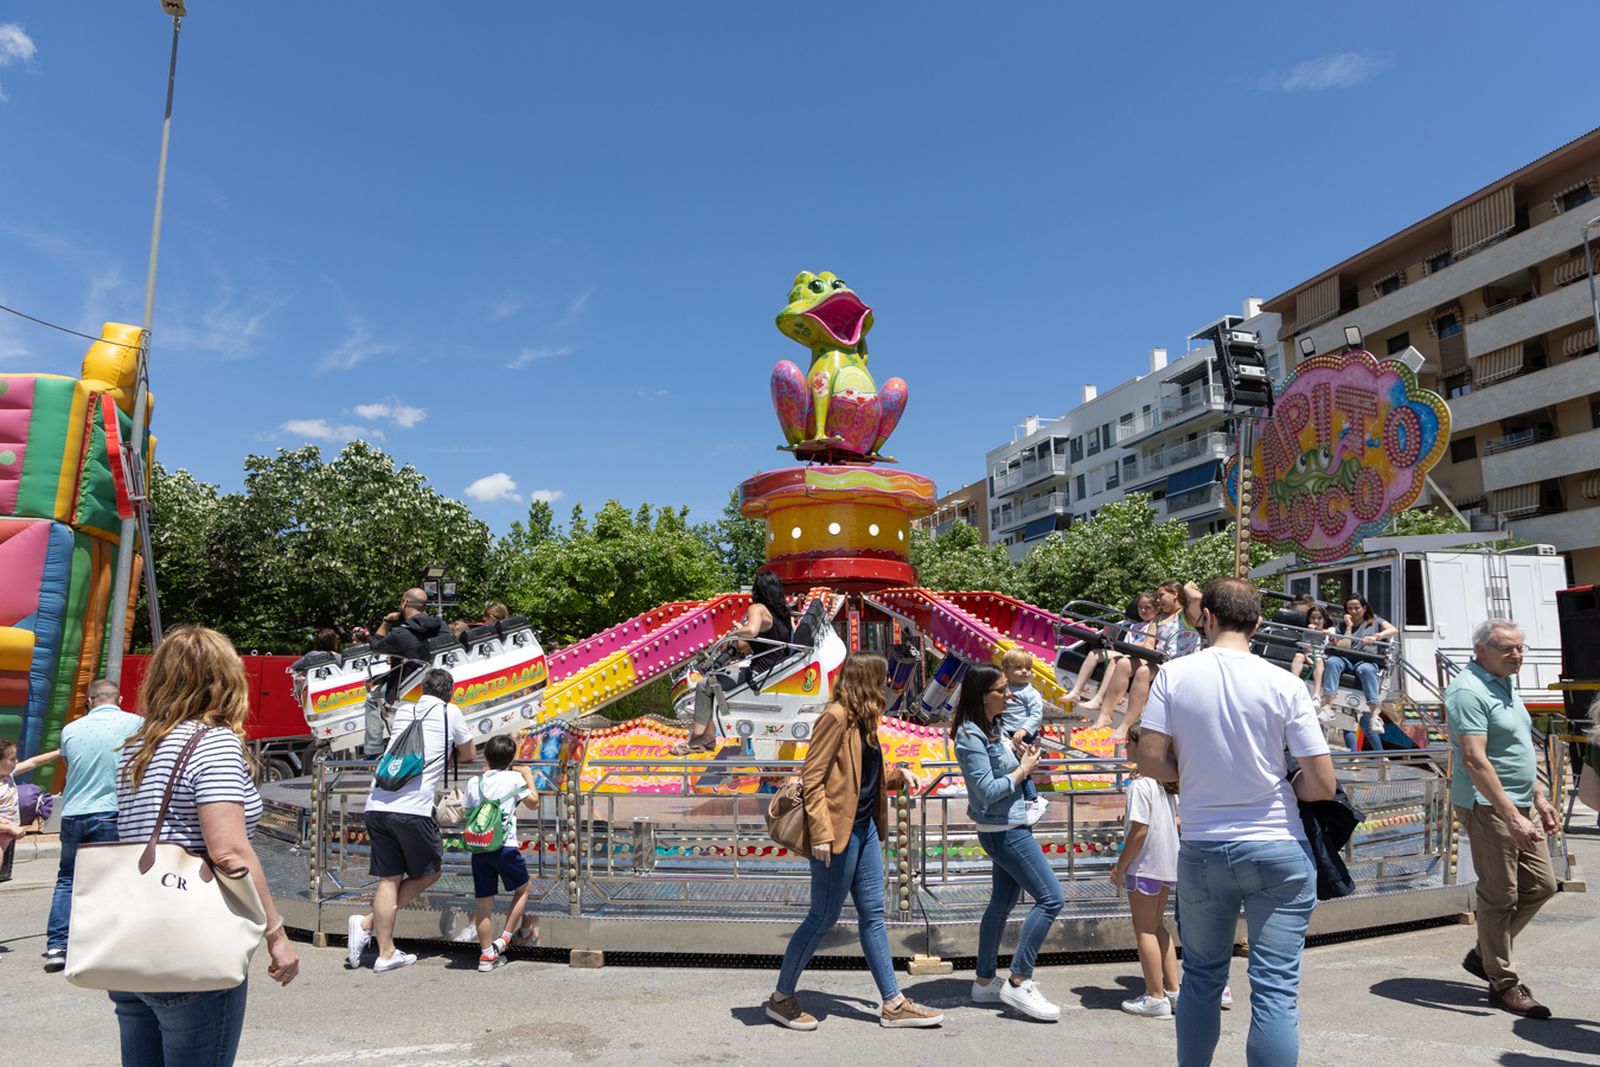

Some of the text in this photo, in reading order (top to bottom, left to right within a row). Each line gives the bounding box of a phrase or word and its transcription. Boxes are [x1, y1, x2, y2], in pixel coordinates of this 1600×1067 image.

[454, 661, 543, 703] SAPITO LOCO
[802, 668, 817, 692] 3
[160, 872, 189, 891] CR
